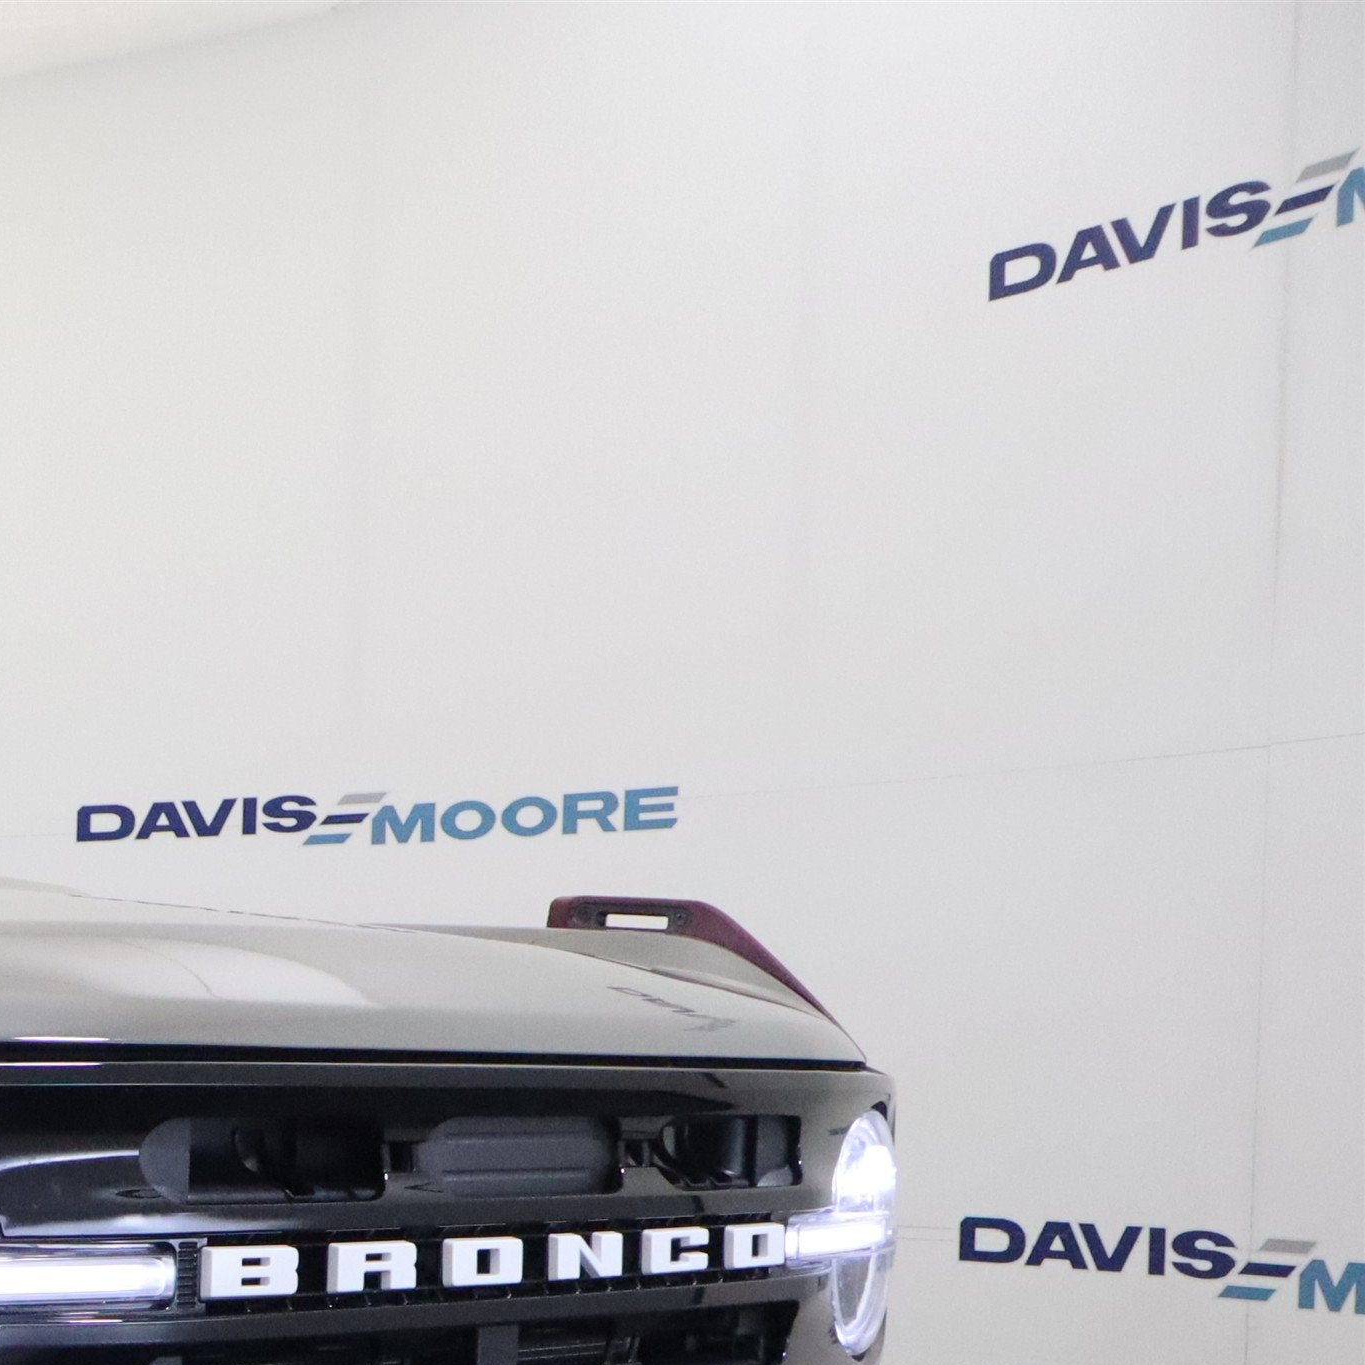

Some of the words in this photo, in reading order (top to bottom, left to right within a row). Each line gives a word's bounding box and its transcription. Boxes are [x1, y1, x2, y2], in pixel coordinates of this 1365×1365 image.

[987, 179, 1273, 302] DAVIS
[76, 795, 318, 843] DAVIS
[370, 786, 680, 846] MOORE
[200, 1222, 786, 1300] BRONCO
[959, 1216, 1237, 1280] DAVIS
